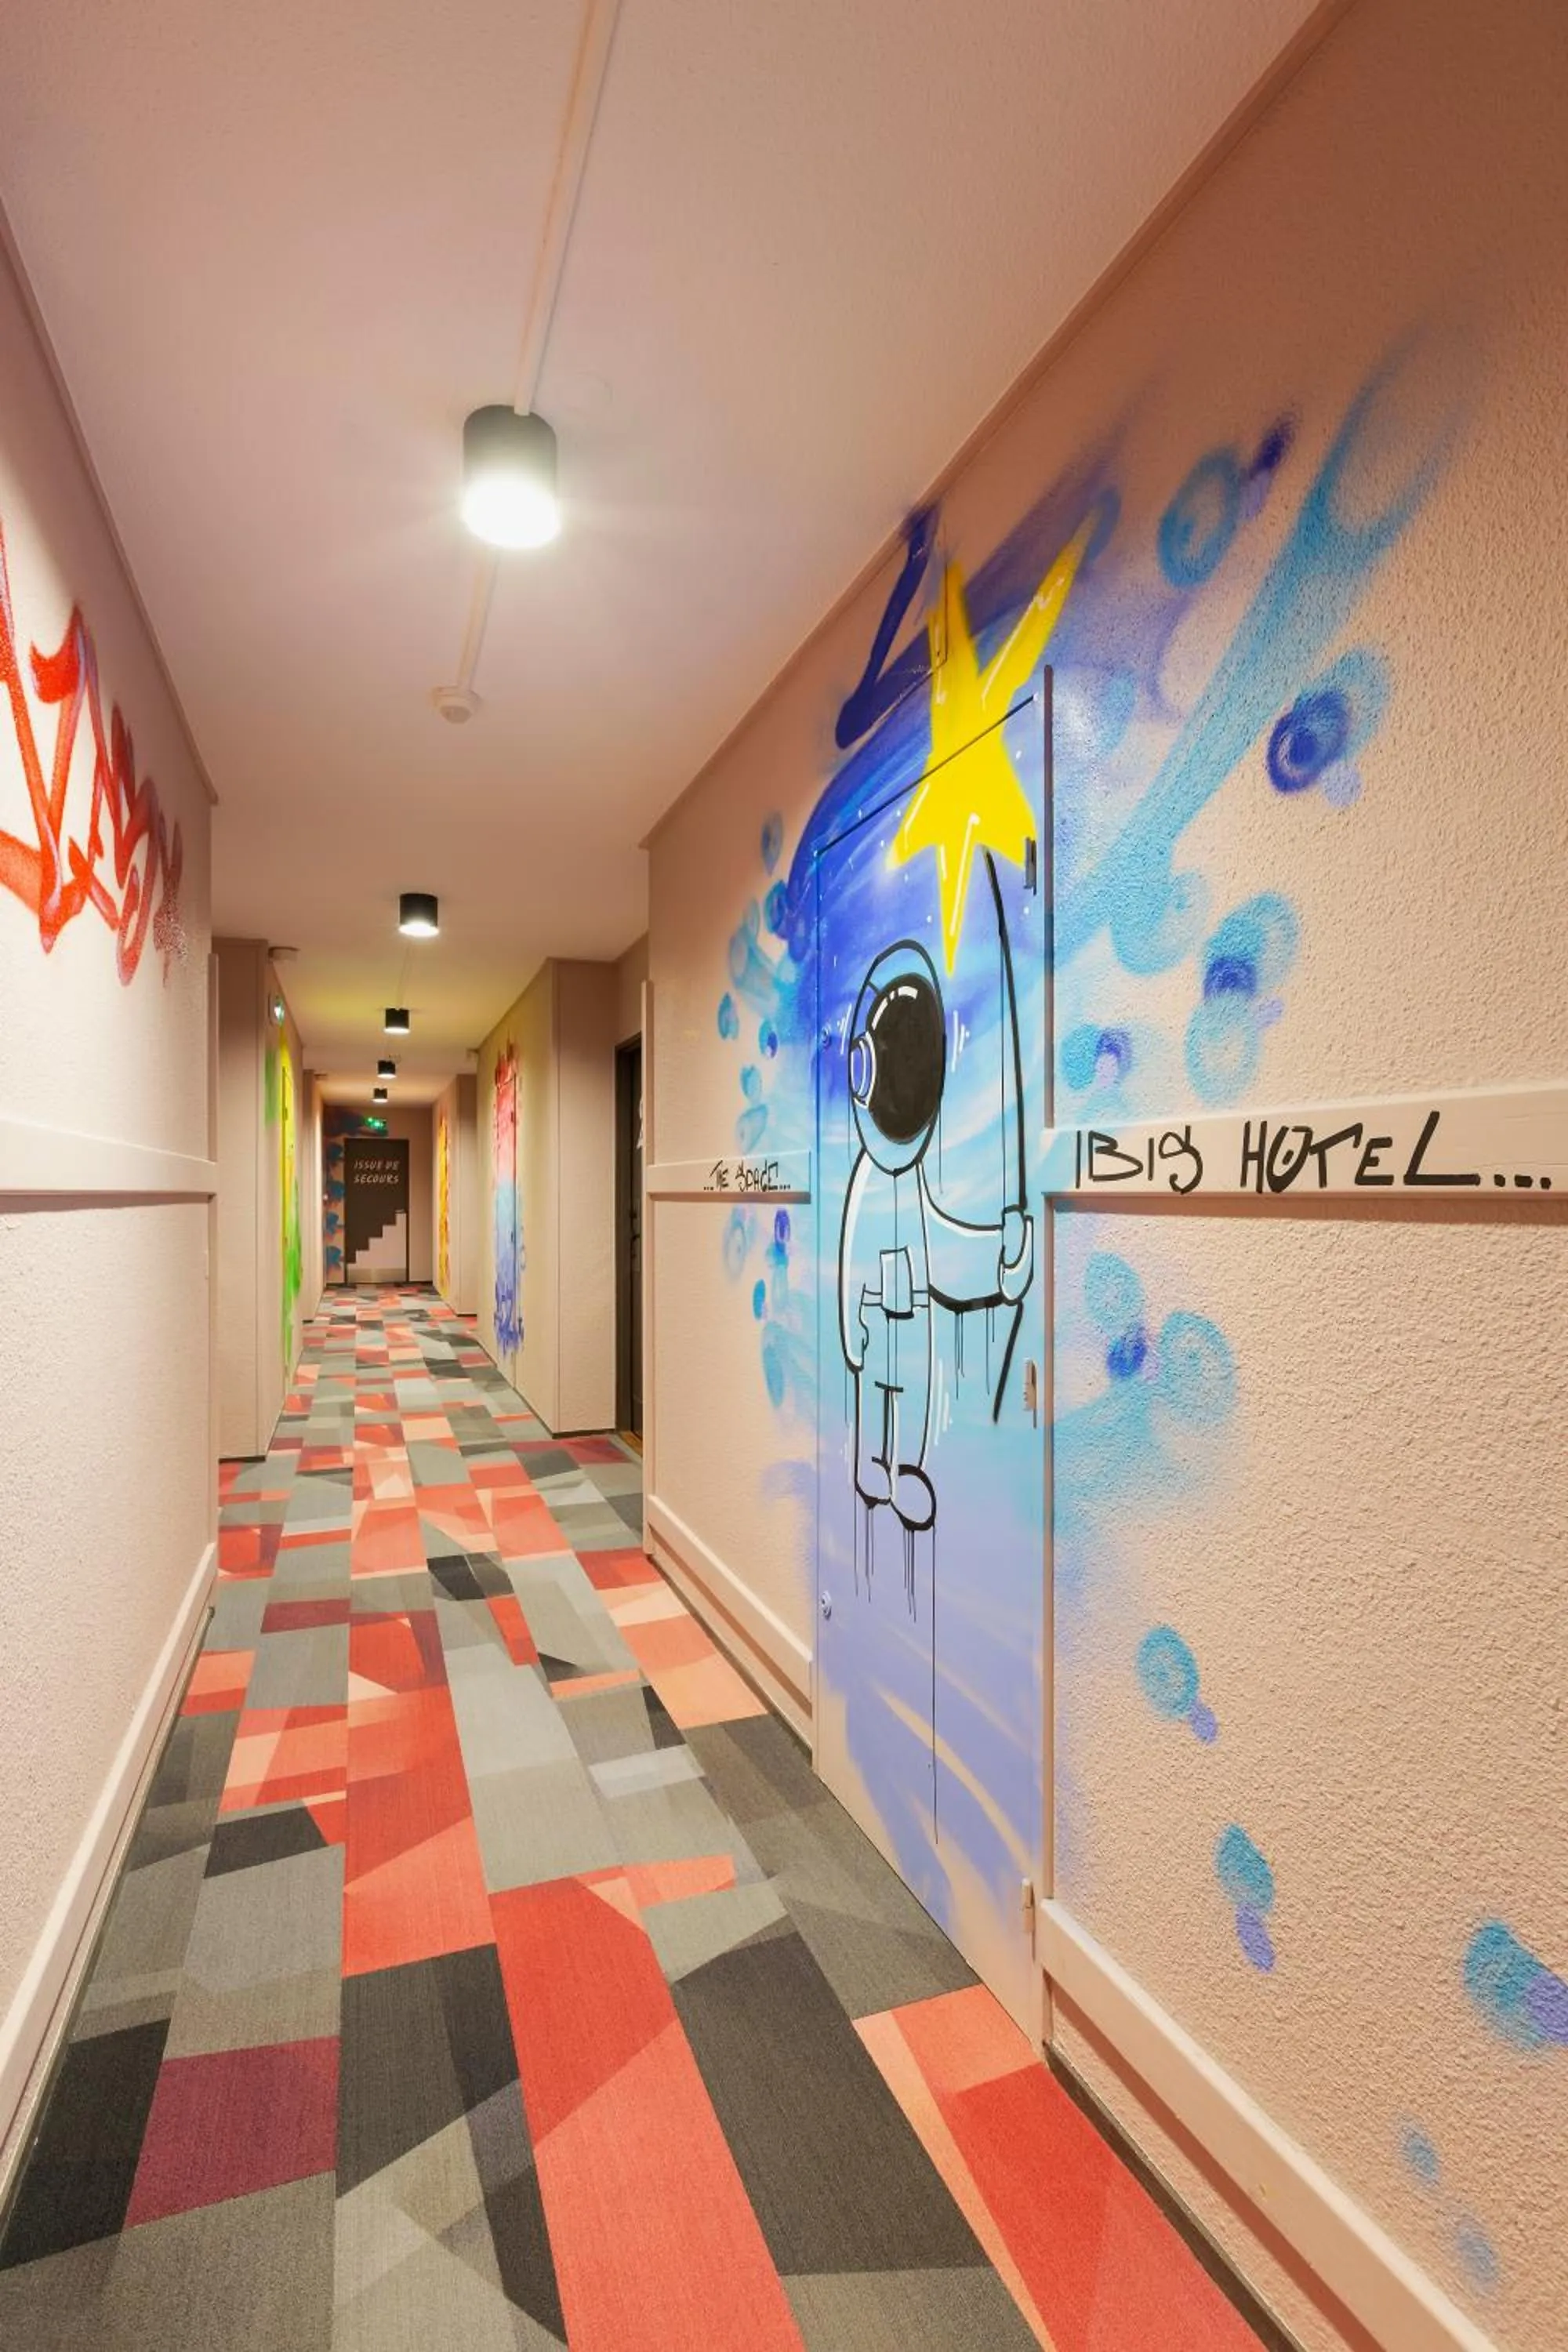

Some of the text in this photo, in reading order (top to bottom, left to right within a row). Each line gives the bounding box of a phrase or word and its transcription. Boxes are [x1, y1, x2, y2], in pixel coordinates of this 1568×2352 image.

[1075, 1123, 1203, 1194] IBIS
[354, 1160, 400, 1171] ISSUE DE
[354, 1174, 400, 1185] SECOURS
